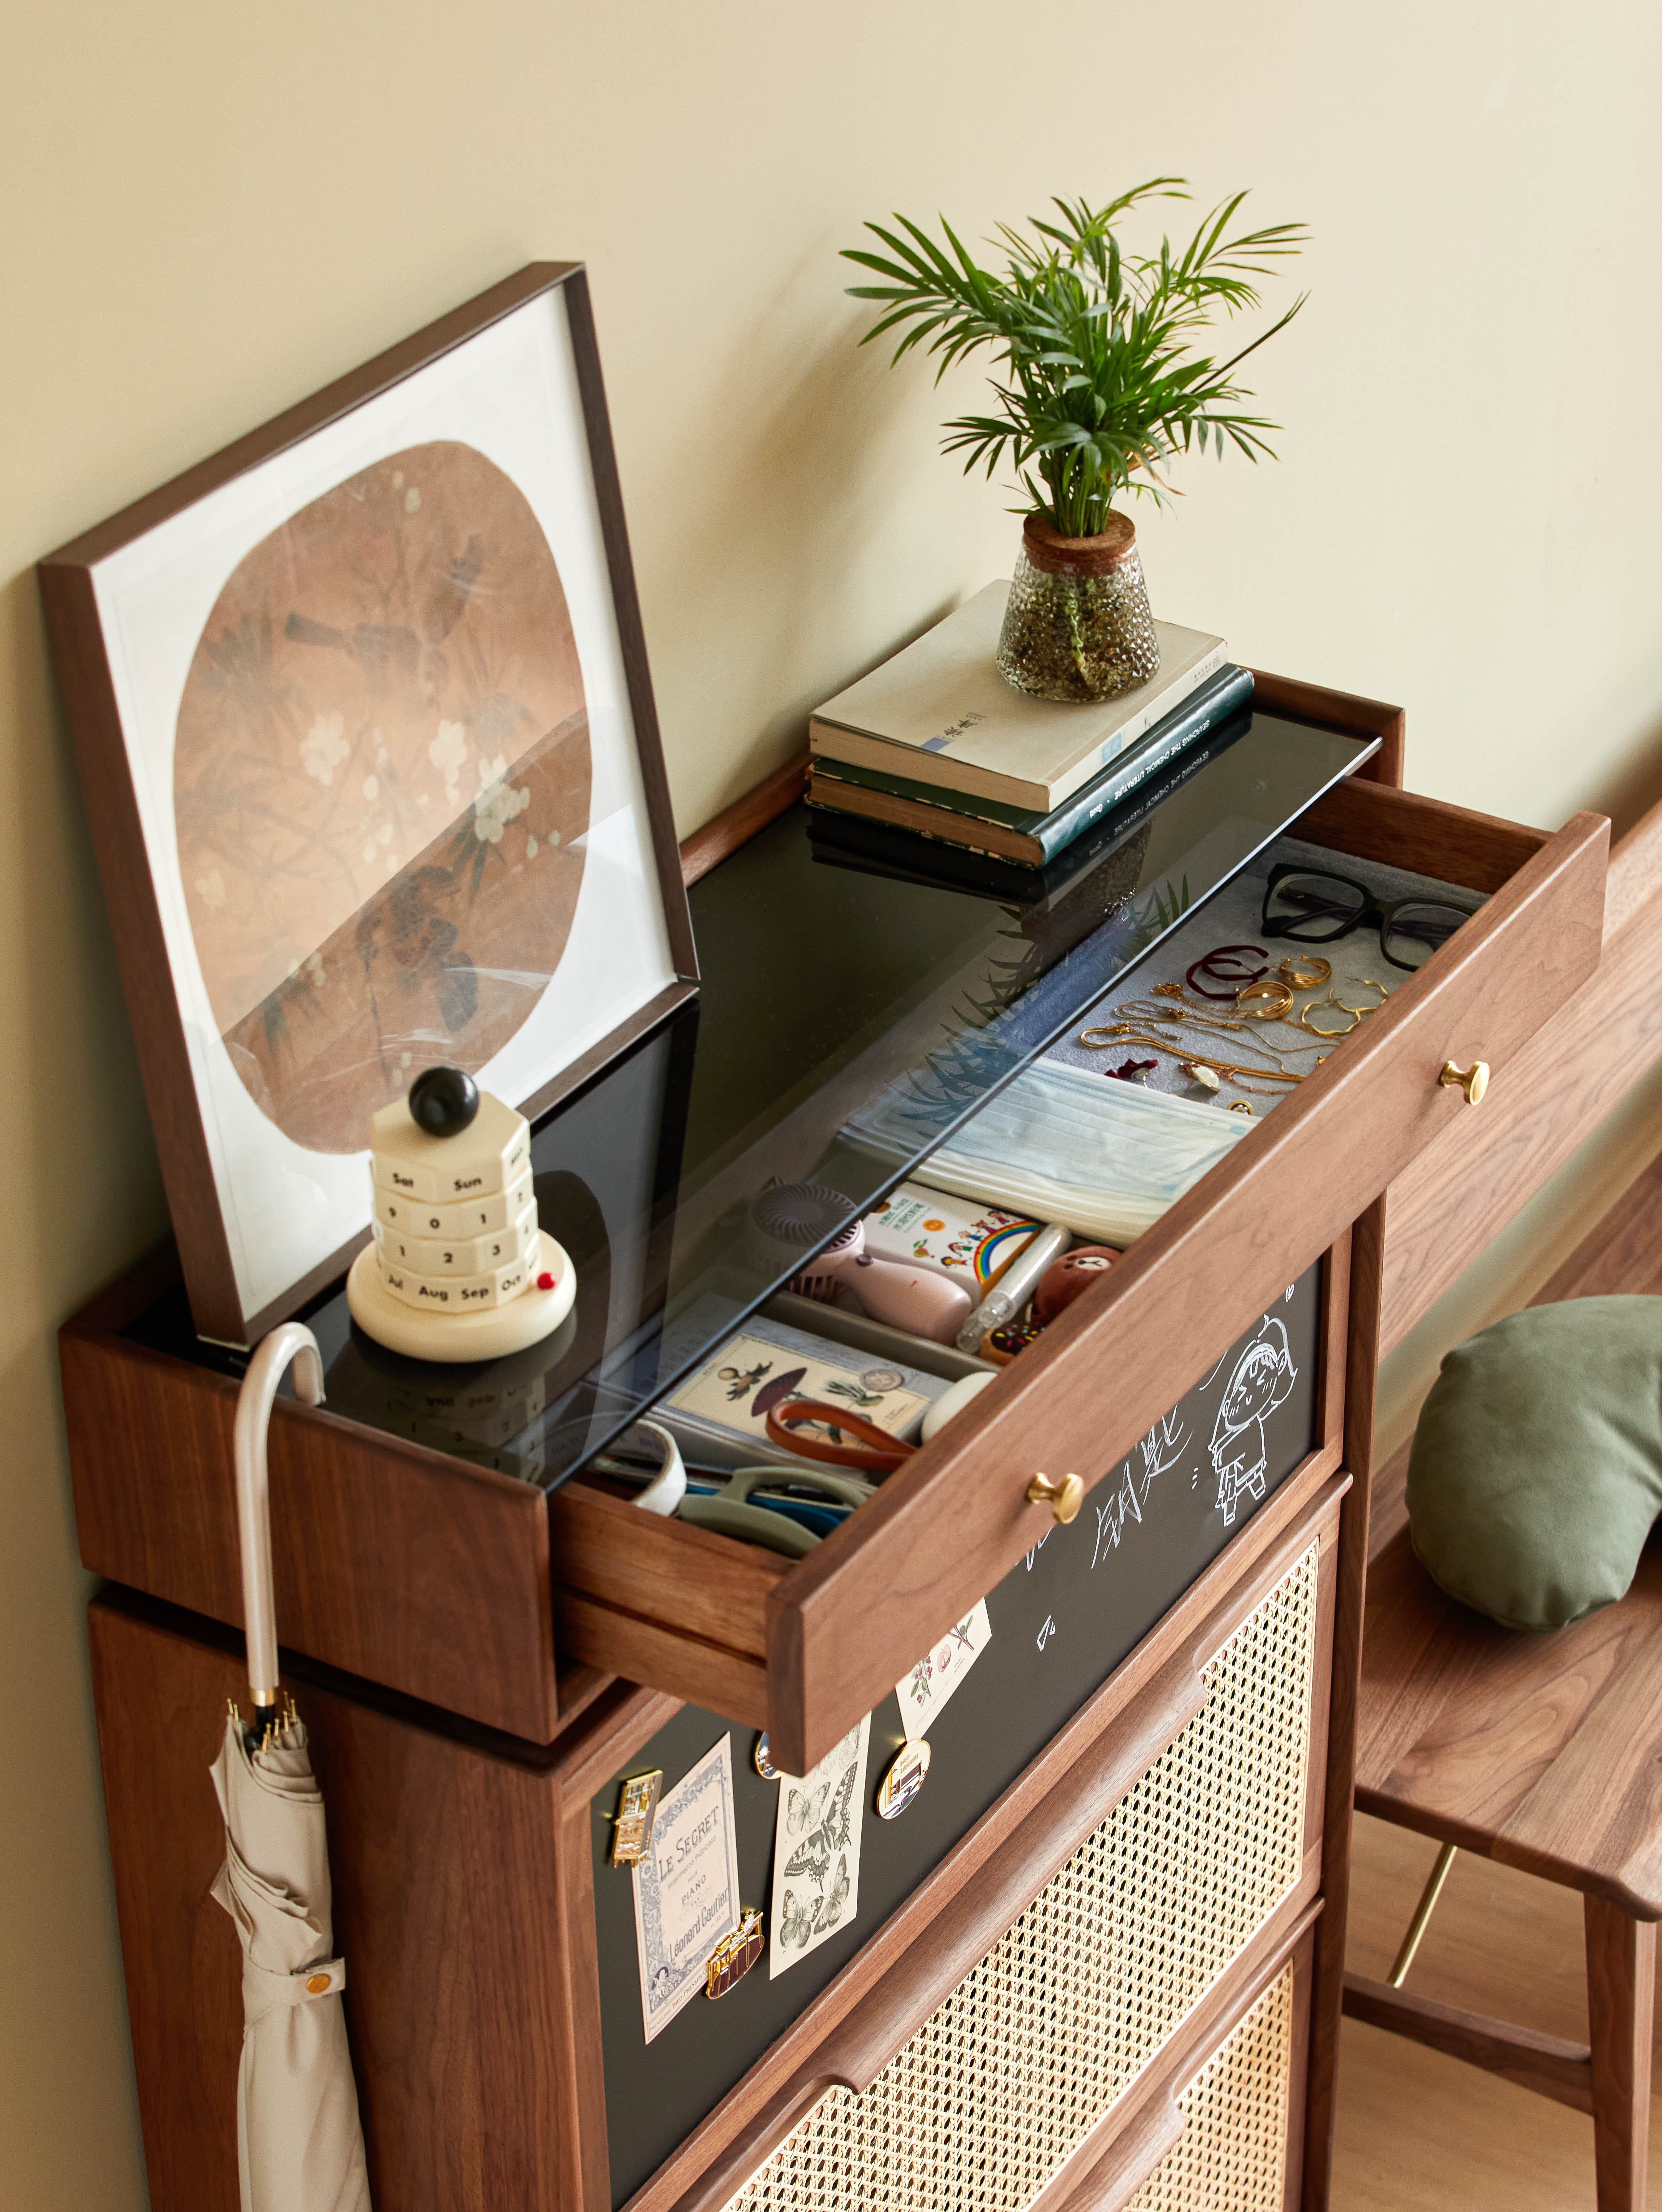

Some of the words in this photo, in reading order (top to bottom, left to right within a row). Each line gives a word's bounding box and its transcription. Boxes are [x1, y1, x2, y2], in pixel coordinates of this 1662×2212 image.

[1182, 720, 1210, 746] SEARCHING
[1171, 742, 1181, 755] THE
[1145, 751, 1170, 774] CHEMICAL
[1114, 771, 1144, 800] LITERATURE
[454, 1177, 482, 1191] Sun
[429, 1218, 440, 1229] 0
[480, 1213, 486, 1224] 1
[399, 1245, 406, 1257] 1
[443, 1252, 453, 1263] 2
[491, 1244, 501, 1256] 3
[388, 1274, 404, 1289] Jul
[419, 1286, 448, 1302] Aug
[461, 1287, 489, 1300] Sep
[501, 1275, 521, 1291] Oct
[658, 1856, 674, 1882] LE
[681, 1874, 706, 1906] PIANO
[701, 1887, 729, 1927] Gautier
